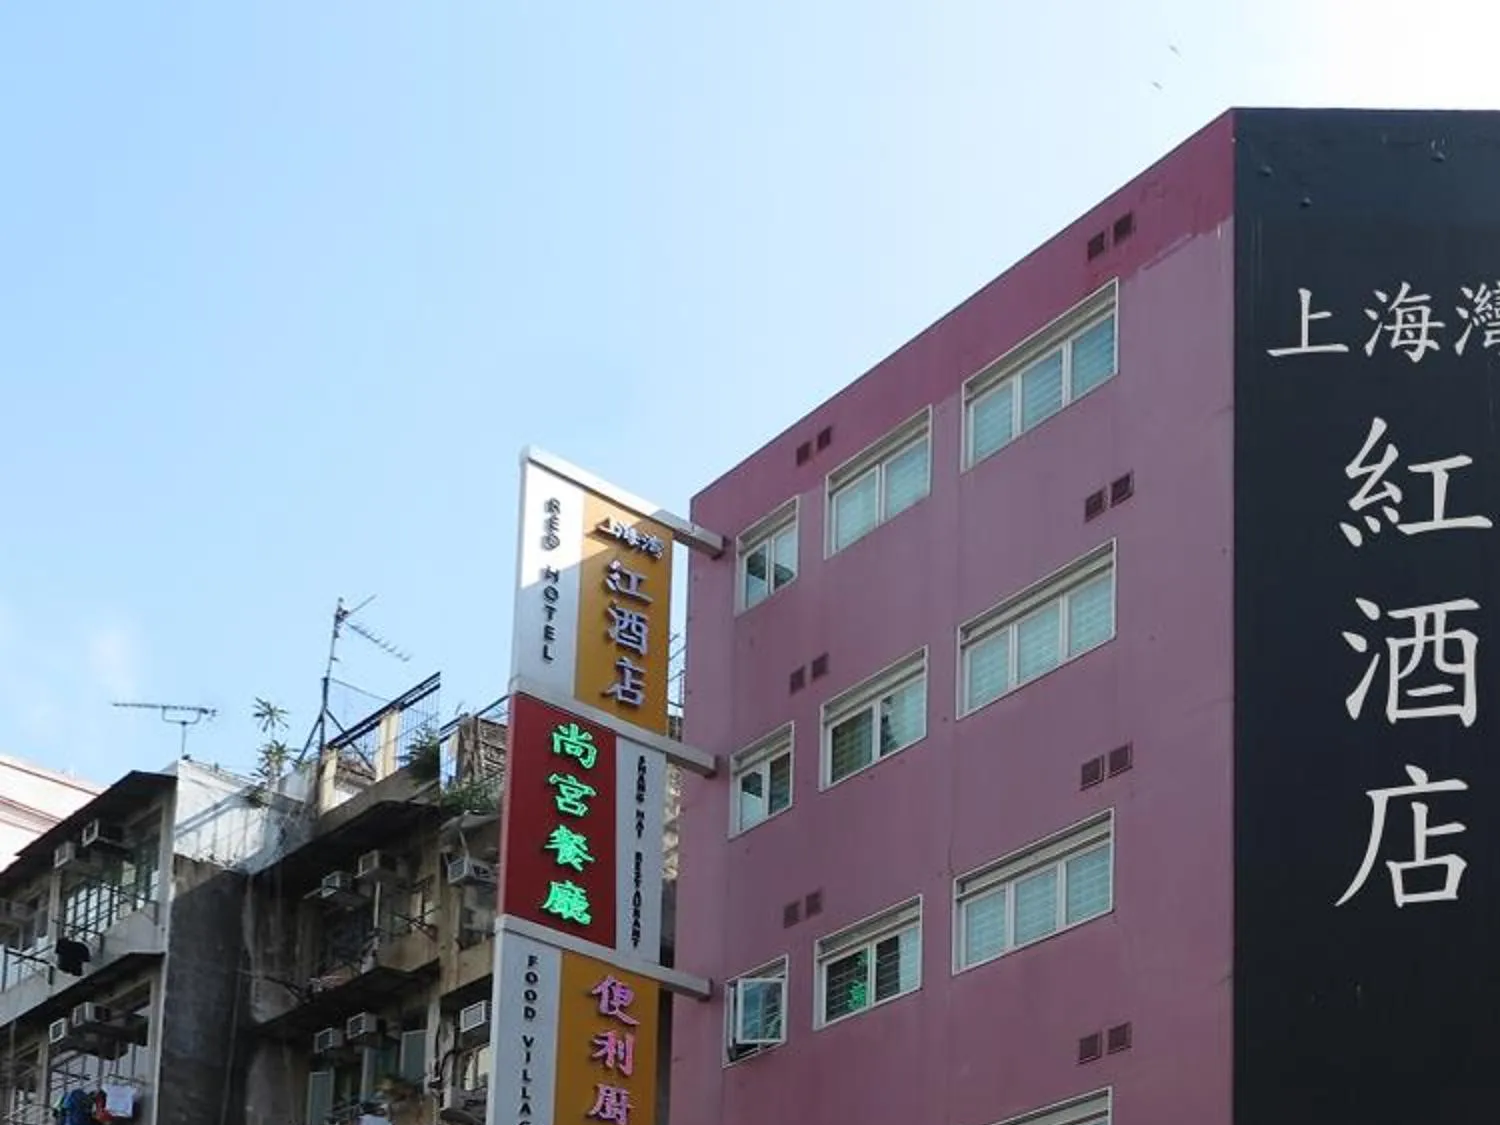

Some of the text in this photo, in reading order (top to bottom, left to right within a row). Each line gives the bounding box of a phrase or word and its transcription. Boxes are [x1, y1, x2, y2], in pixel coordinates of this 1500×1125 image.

[540, 497, 561, 662] RED HOTEL
[1335, 416, 1494, 909] 紅酒店
[541, 721, 599, 928] 尚宮餐廳
[522, 955, 540, 1022] FOOD
